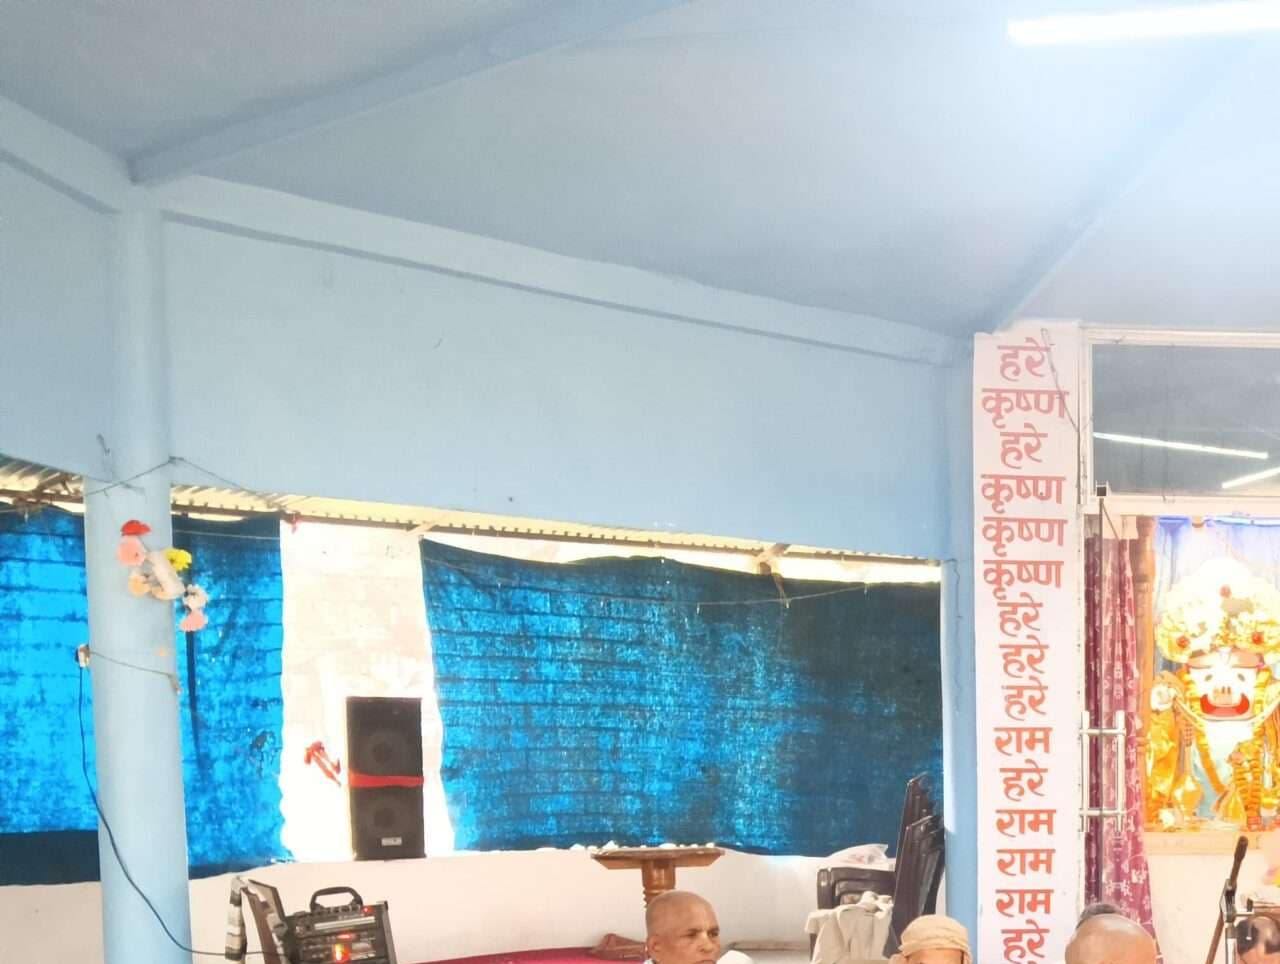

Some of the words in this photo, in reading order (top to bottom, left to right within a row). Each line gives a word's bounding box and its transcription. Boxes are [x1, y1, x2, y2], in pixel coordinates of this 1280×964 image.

[998, 337, 1050, 381] हरे
[981, 388, 1069, 428] कृष्ण
[1000, 422, 1048, 469] हरे
[981, 474, 1066, 514] कृष्ण
[982, 516, 1068, 557] कृष्ण
[983, 559, 1064, 600] कृष्ण
[997, 591, 1043, 637] हरे
[999, 634, 1049, 678] हरे
[1001, 675, 1048, 720] हरे
[993, 726, 1053, 756] राम
[999, 758, 1048, 801] हरे
[996, 809, 1056, 837] राम
[996, 848, 1056, 876] राम
[996, 888, 1054, 917] राम
[1001, 919, 1050, 964] हरे
